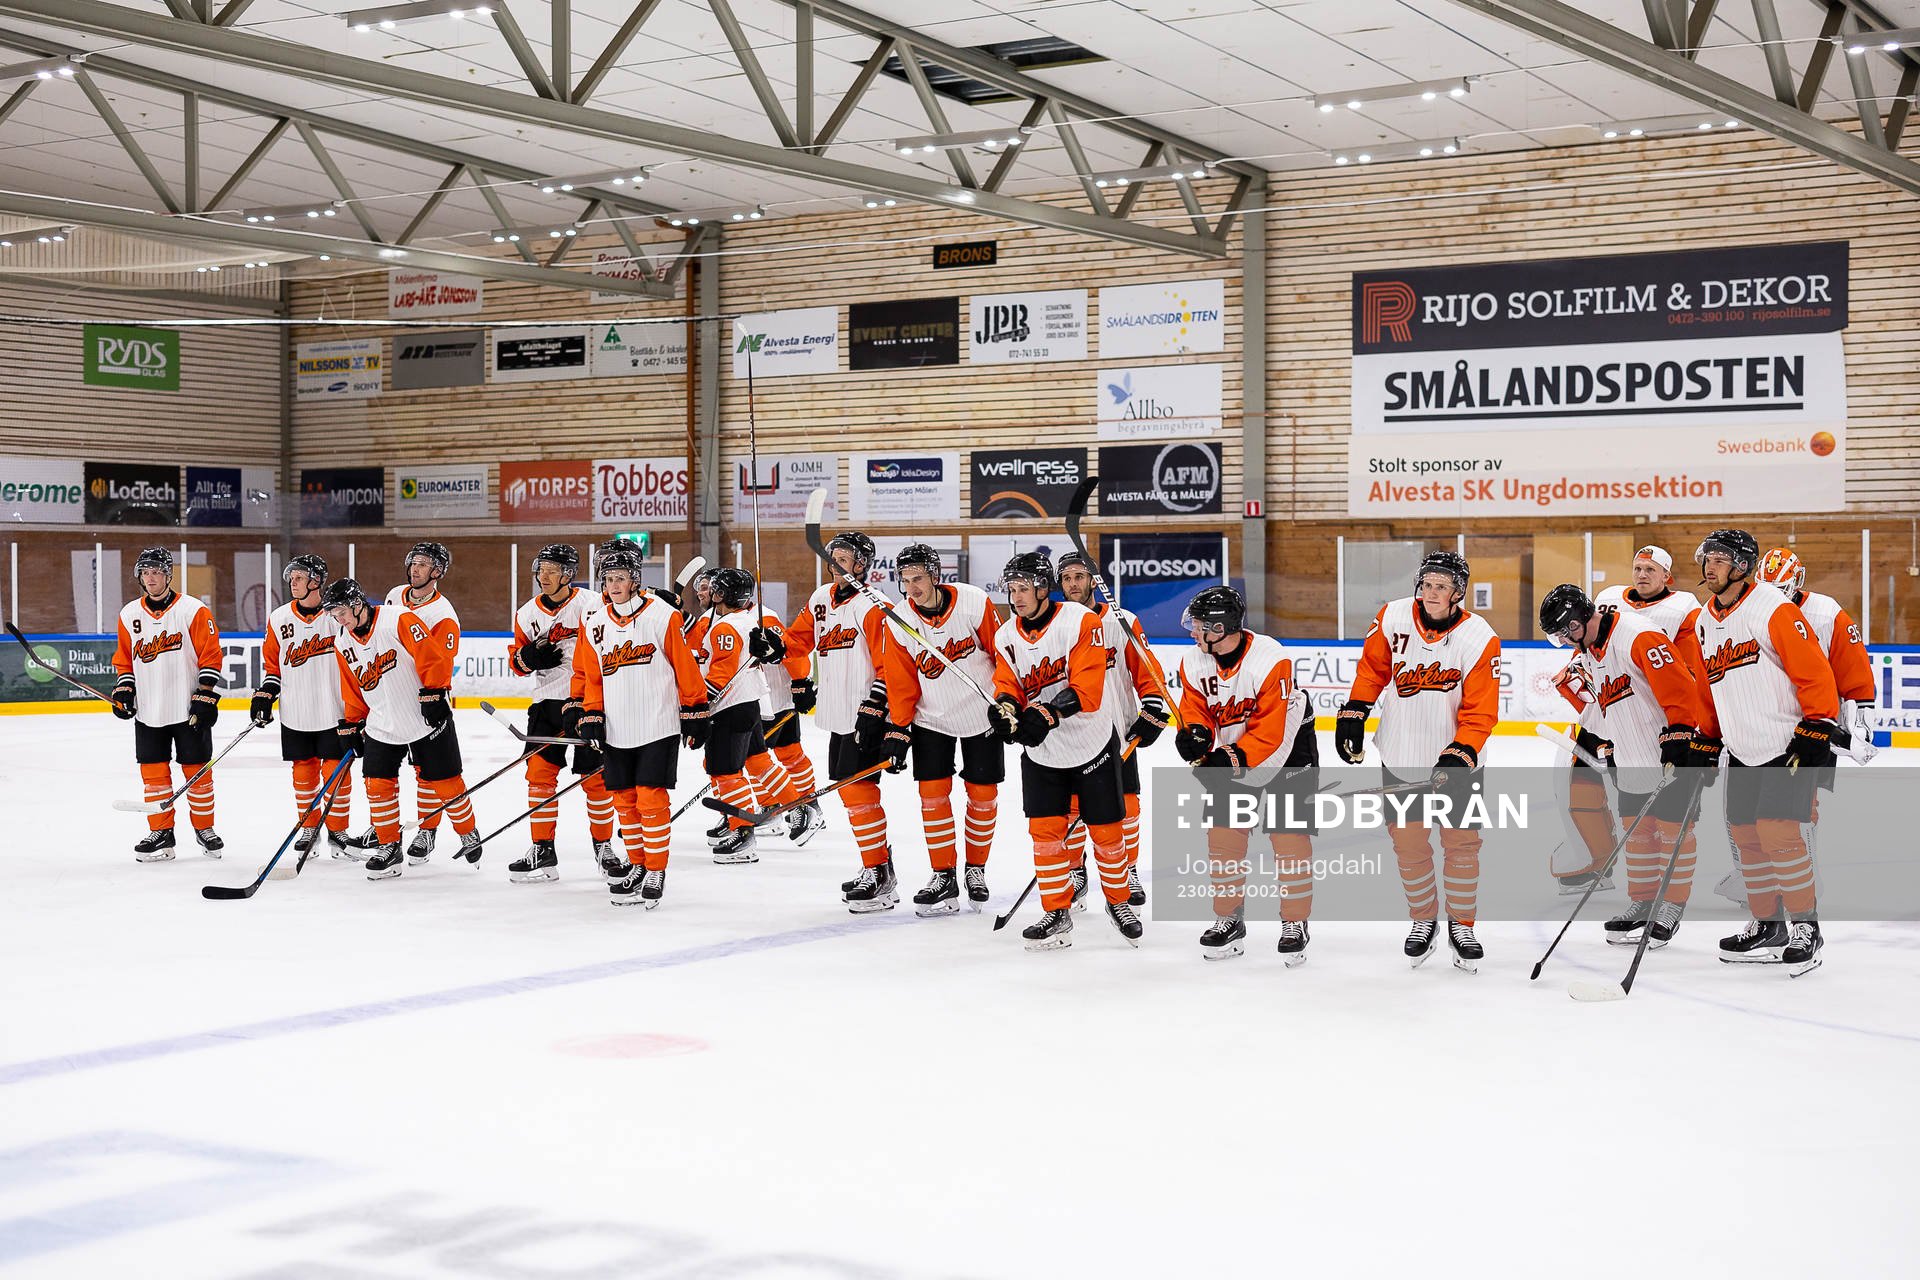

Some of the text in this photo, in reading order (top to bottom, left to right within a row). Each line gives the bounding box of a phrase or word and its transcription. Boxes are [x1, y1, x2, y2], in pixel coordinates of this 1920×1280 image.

[938, 247, 992, 264] BRONS
[1422, 274, 1832, 327] RIJO SOLFILM & DEKOR
[975, 304, 1028, 344] JPB
[1667, 306, 1832, 324] 0472-390 100 rijosolfilm.se
[764, 334, 835, 347] Alvesta Energi
[98, 336, 167, 366] RYDS
[300, 359, 350, 372] NILSSONS
[366, 356, 379, 368] TV
[142, 369, 166, 378] GLAS
[1383, 355, 1804, 412] SMÅLANDSPOSTEN
[1123, 399, 1174, 420] Allbo
[1118, 421, 1205, 434] begravningsbyrå
[1717, 436, 1806, 455] Swedbank
[791, 462, 823, 473] OJMH
[979, 459, 1079, 476] wellness
[1162, 466, 1209, 485] AFM
[1368, 457, 1503, 476] Stolt sponsor av
[195, 481, 213, 493] Allt
[217, 481, 232, 493] för
[418, 480, 480, 493] EUROMASTER
[528, 477, 588, 496] TORPS
[598, 464, 688, 496] Tobbes
[1036, 475, 1079, 485] studio
[0, 481, 82, 504] erome
[109, 480, 175, 500] LocTech
[331, 488, 382, 504] MIDCON
[1107, 489, 1214, 502] ALVESTA FÄRG & MÅLERI
[1368, 474, 1724, 506] Alvesta SK Ungdomssektion
[601, 496, 687, 517] Grävteknik
[1108, 559, 1216, 577] OTTOSSON
[132, 619, 142, 634] 9
[280, 623, 294, 640] 23
[409, 622, 428, 643] 21
[69, 650, 95, 661] Dina
[342, 647, 358, 664] 21
[1646, 644, 1675, 669] 95
[69, 663, 117, 675] Försäkri
